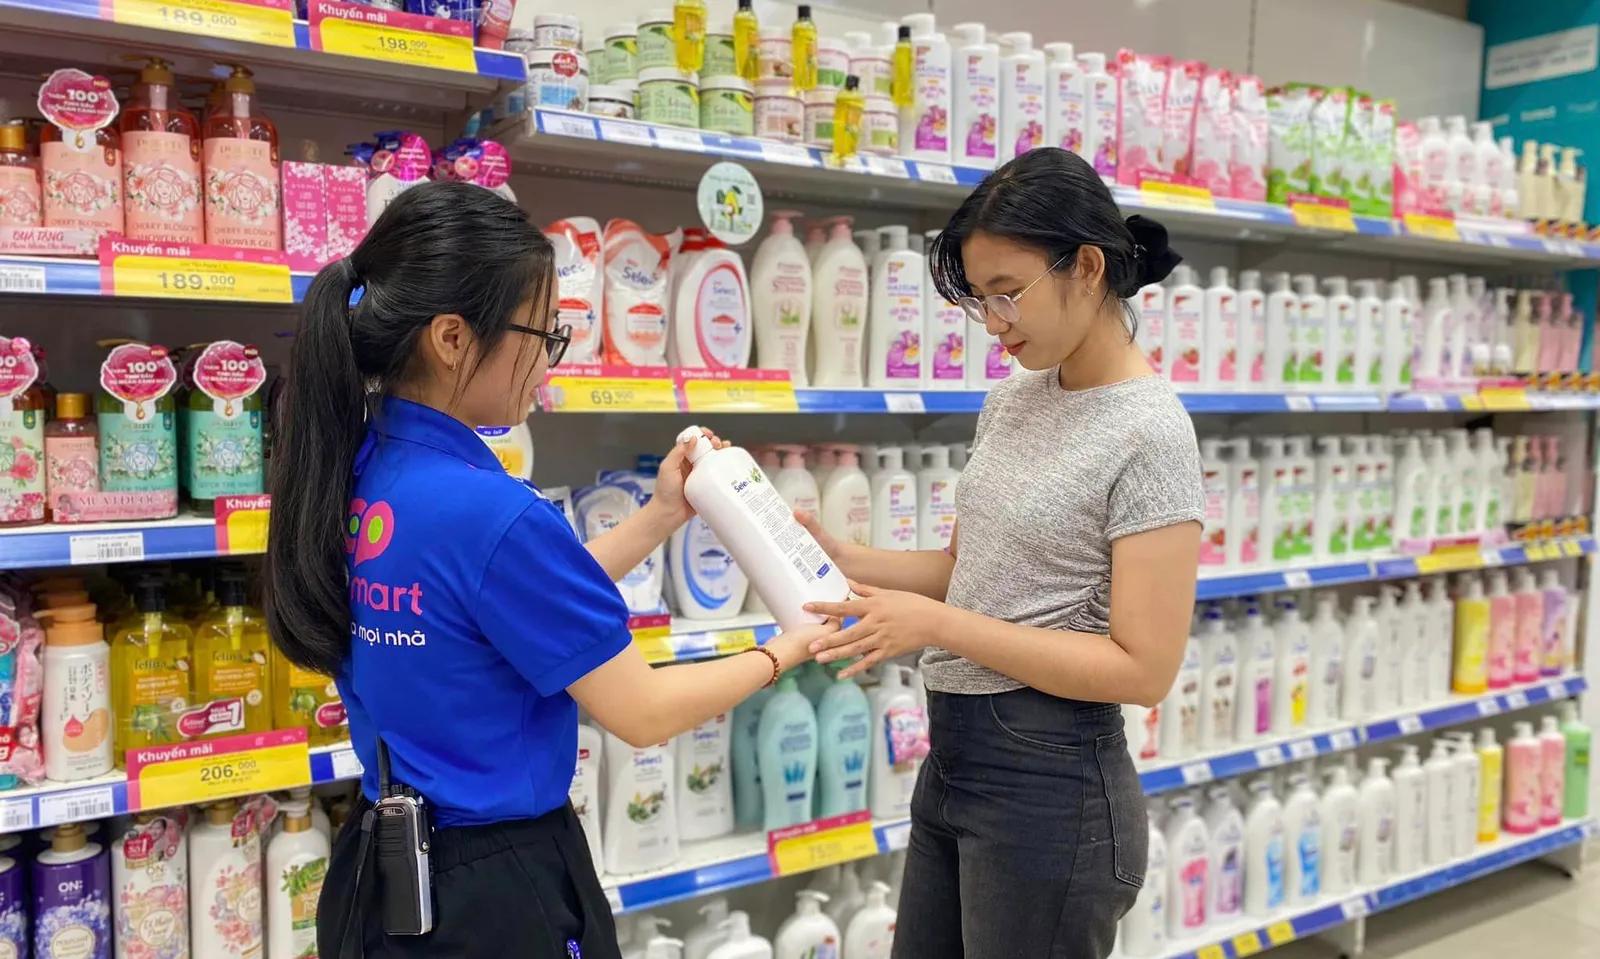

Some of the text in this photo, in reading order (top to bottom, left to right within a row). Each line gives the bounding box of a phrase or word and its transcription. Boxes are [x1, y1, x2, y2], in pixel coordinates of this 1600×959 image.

[318, 3, 387, 24] Khuyến mãi
[111, 242, 190, 257] Khuyến mãi
[217, 237, 254, 248] SHOWER
[359, 625, 381, 647] mọi
[385, 630, 426, 646] nhà
[137, 746, 187, 765] Khuyến
[190, 743, 214, 756] mãi
